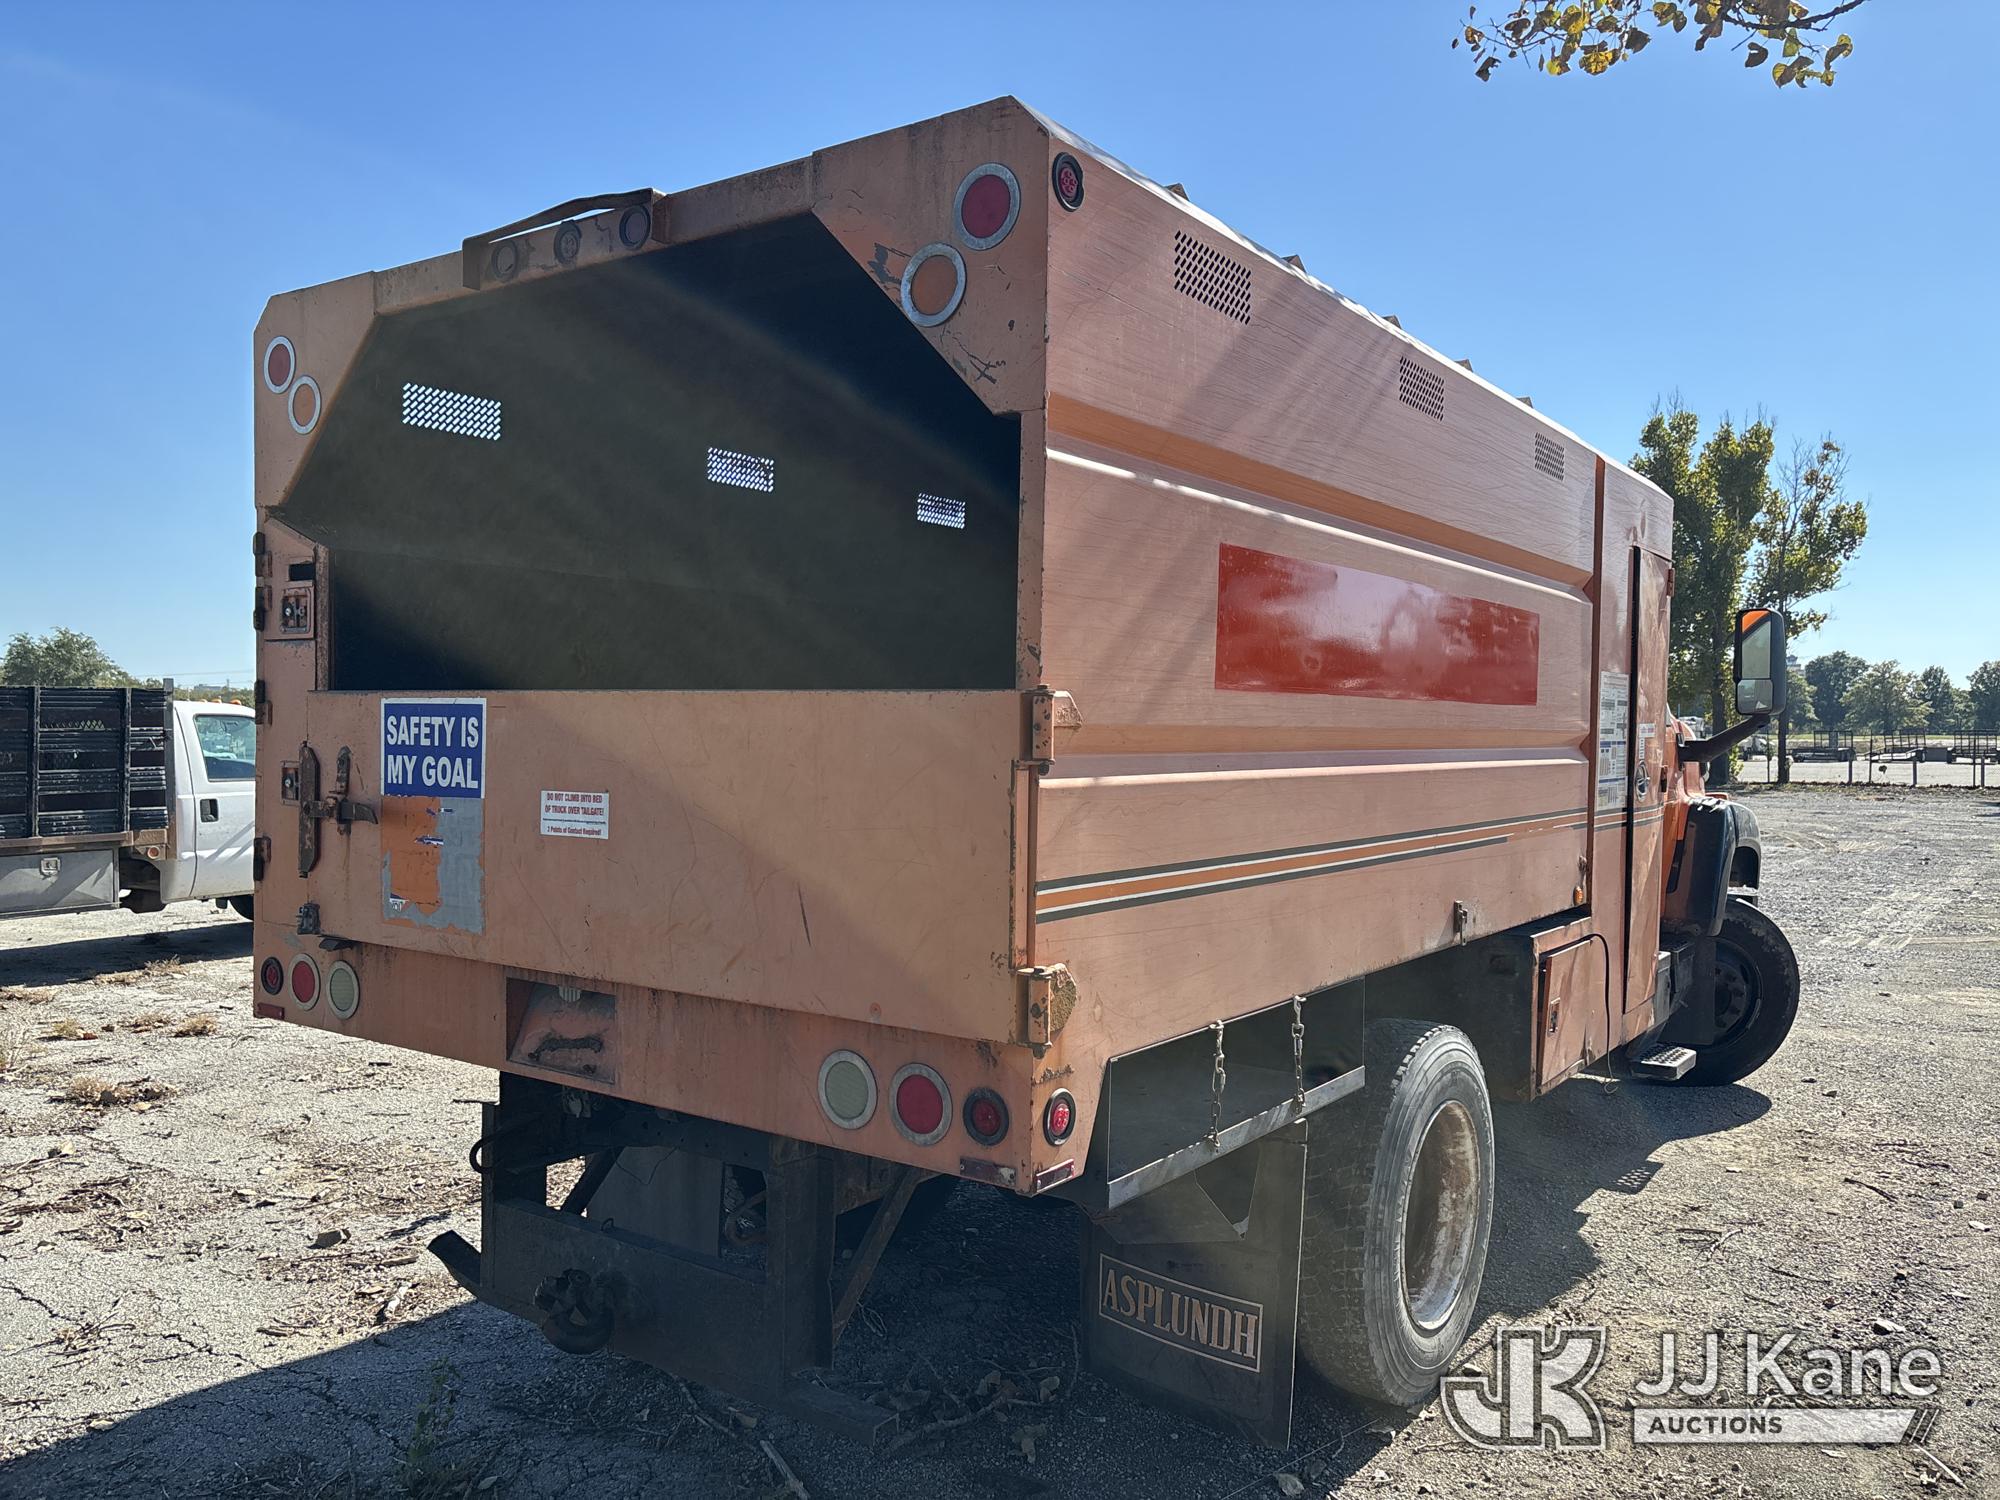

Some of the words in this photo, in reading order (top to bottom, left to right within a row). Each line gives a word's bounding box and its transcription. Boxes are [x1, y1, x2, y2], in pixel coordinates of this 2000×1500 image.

[387, 716, 455, 747] SAFETY
[461, 716, 479, 748] IS
[387, 754, 417, 785] MY
[422, 755, 479, 789] GOAL
[545, 804, 551, 813] OF
[552, 805, 567, 814] TRUCK
[568, 806, 580, 814] OVER
[581, 807, 604, 816] TAILGATE!
[546, 792, 553, 801] DO
[554, 793, 564, 801] NOT
[565, 793, 579, 802] CLIMB
[580, 794, 591, 803] INTO
[592, 795, 603, 803] BED
[1102, 1268, 1258, 1360] ASPLUNDH
